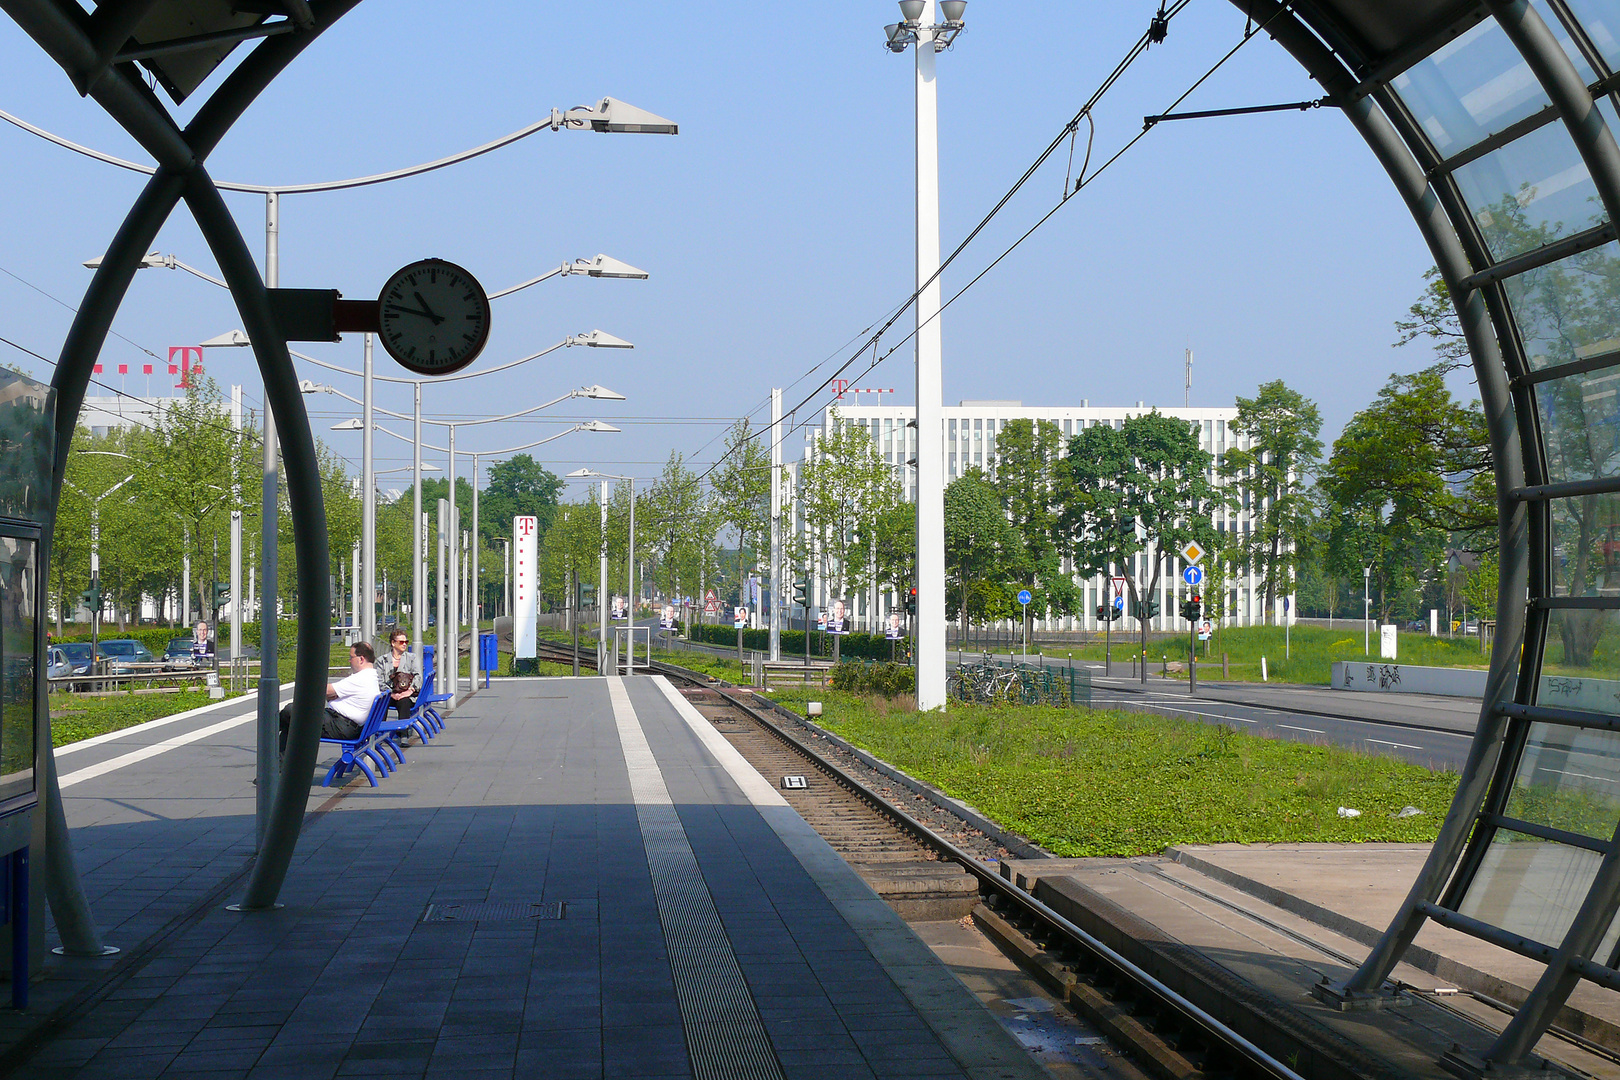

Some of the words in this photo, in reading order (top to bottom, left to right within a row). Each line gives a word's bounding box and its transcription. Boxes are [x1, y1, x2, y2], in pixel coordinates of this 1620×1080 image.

[169, 347, 202, 388] T
[832, 379, 848, 399] T
[519, 518, 533, 535] T
[788, 777, 803, 786] H
